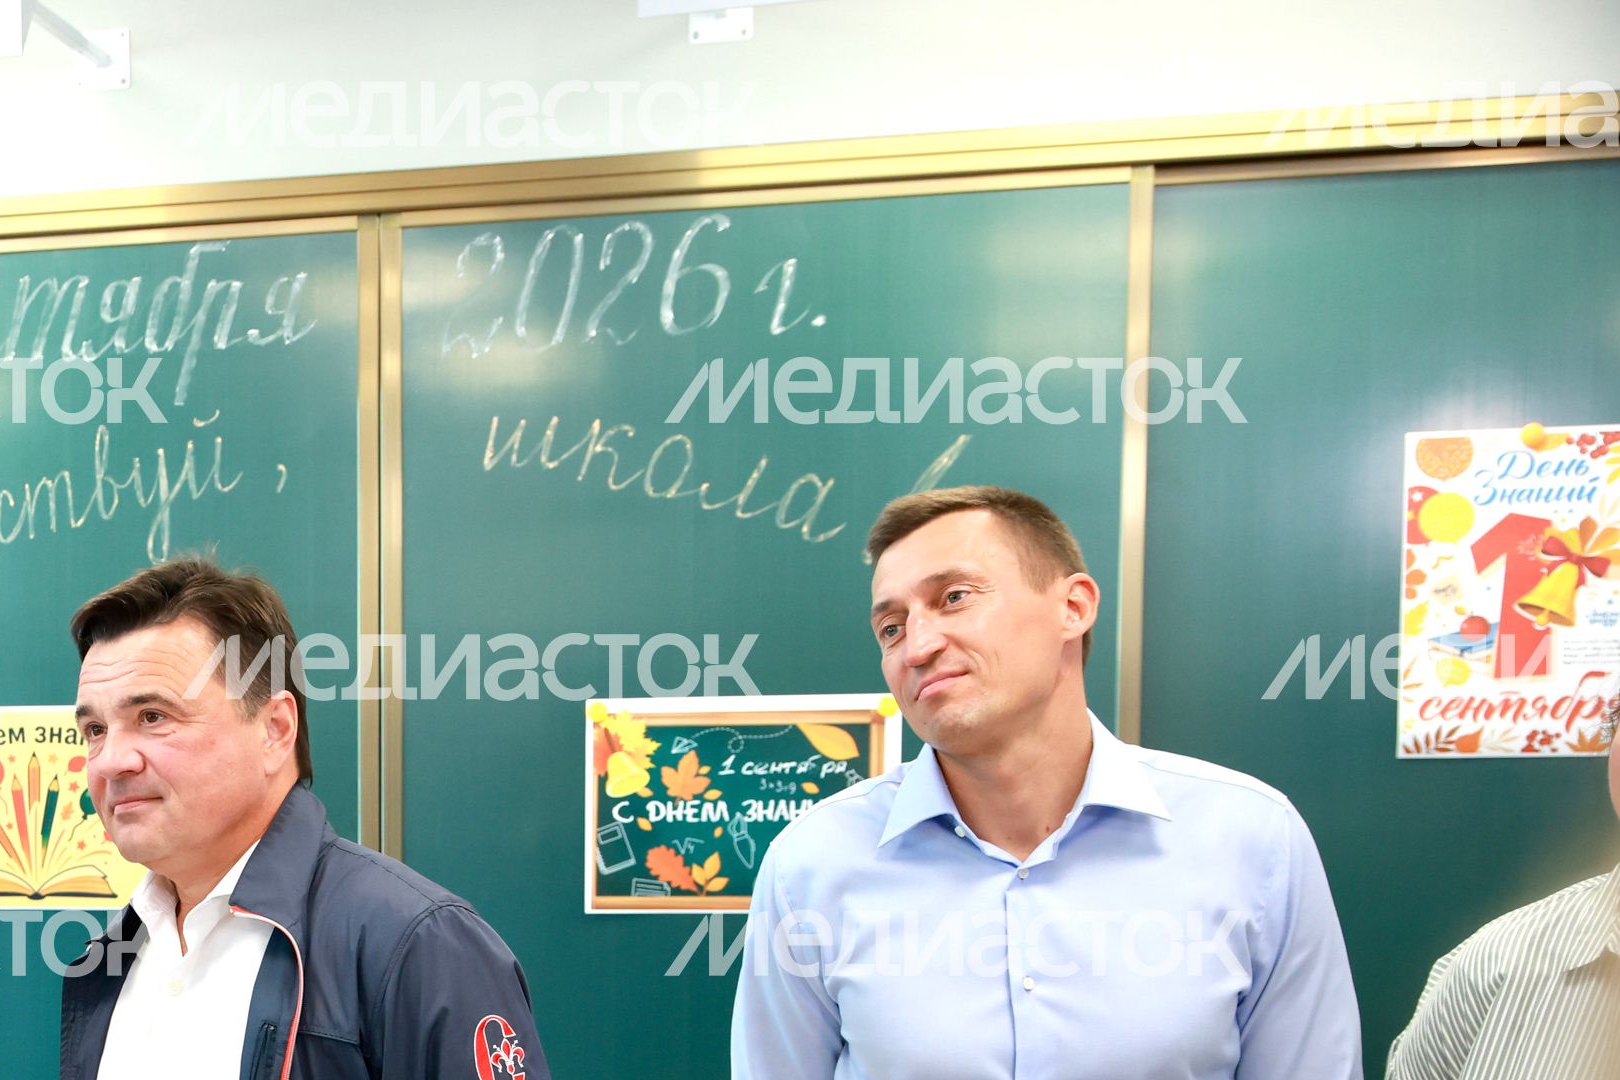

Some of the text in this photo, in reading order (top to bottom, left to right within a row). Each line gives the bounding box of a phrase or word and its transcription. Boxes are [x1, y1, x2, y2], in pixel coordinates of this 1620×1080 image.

[441, 212, 731, 359] 2026
[1497, 451, 1589, 480] День
[1474, 470, 1600, 506] Знаний
[34, 726, 85, 746] зна
[718, 754, 736, 775] 1
[646, 799, 730, 823] ДНЕМ
